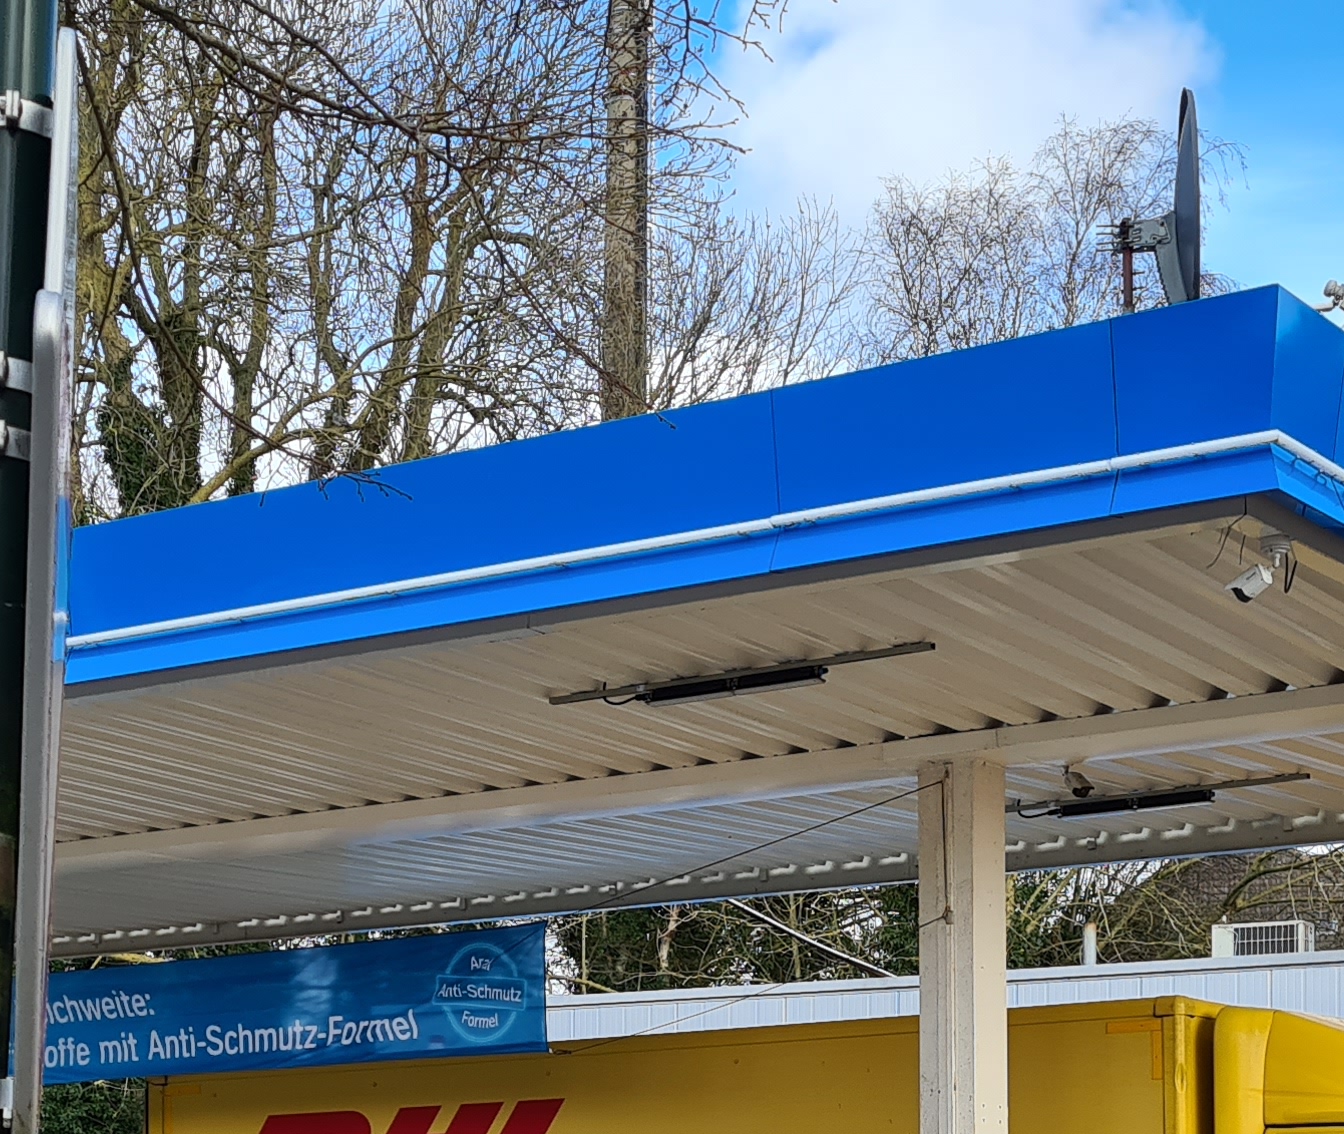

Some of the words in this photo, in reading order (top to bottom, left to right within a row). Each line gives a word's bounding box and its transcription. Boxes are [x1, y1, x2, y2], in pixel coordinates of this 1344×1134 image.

[438, 982, 522, 1003] Anti-Schmutz
[46, 989, 155, 1025] ichweite:
[462, 1010, 499, 1029] Formel
[99, 1031, 138, 1064] mit
[148, 1008, 419, 1060] Anti-Schmutz-Formel
